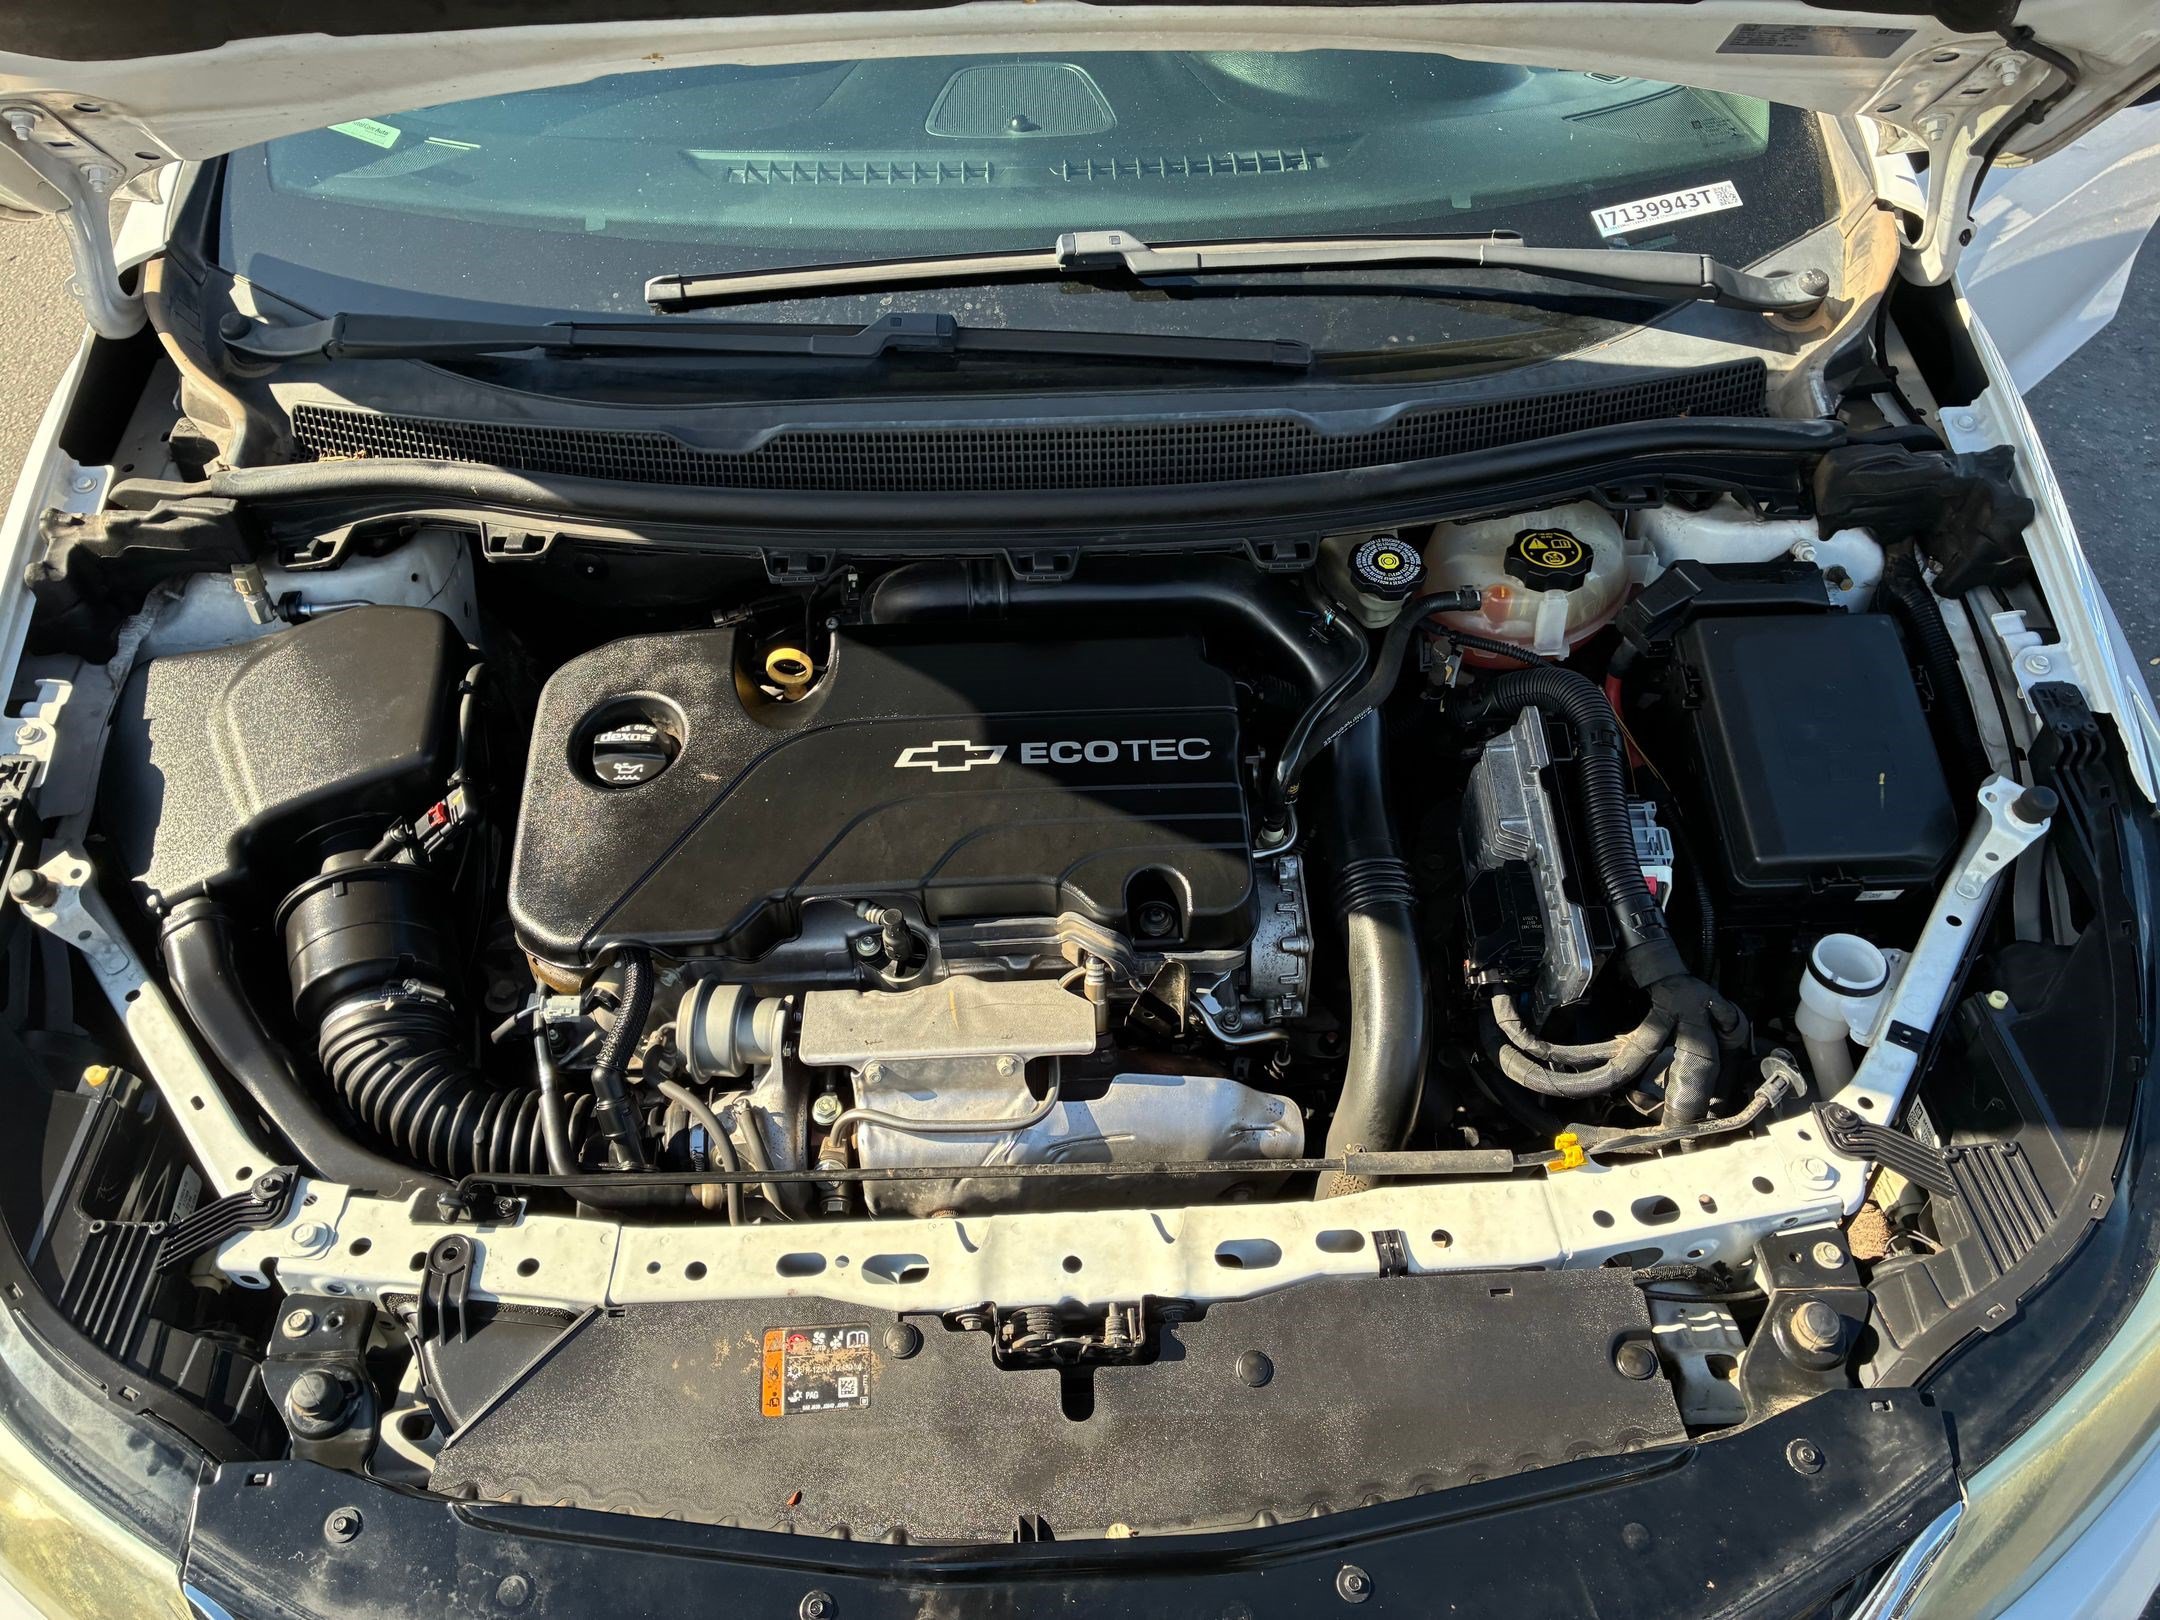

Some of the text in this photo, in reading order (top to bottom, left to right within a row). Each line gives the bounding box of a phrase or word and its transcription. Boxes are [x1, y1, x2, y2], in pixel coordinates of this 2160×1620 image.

[1598, 189, 1711, 229] I7139943T
[600, 731, 653, 742] dexos
[1020, 737, 1211, 765] ECOTEC
[806, 1391, 819, 1400] PAG
